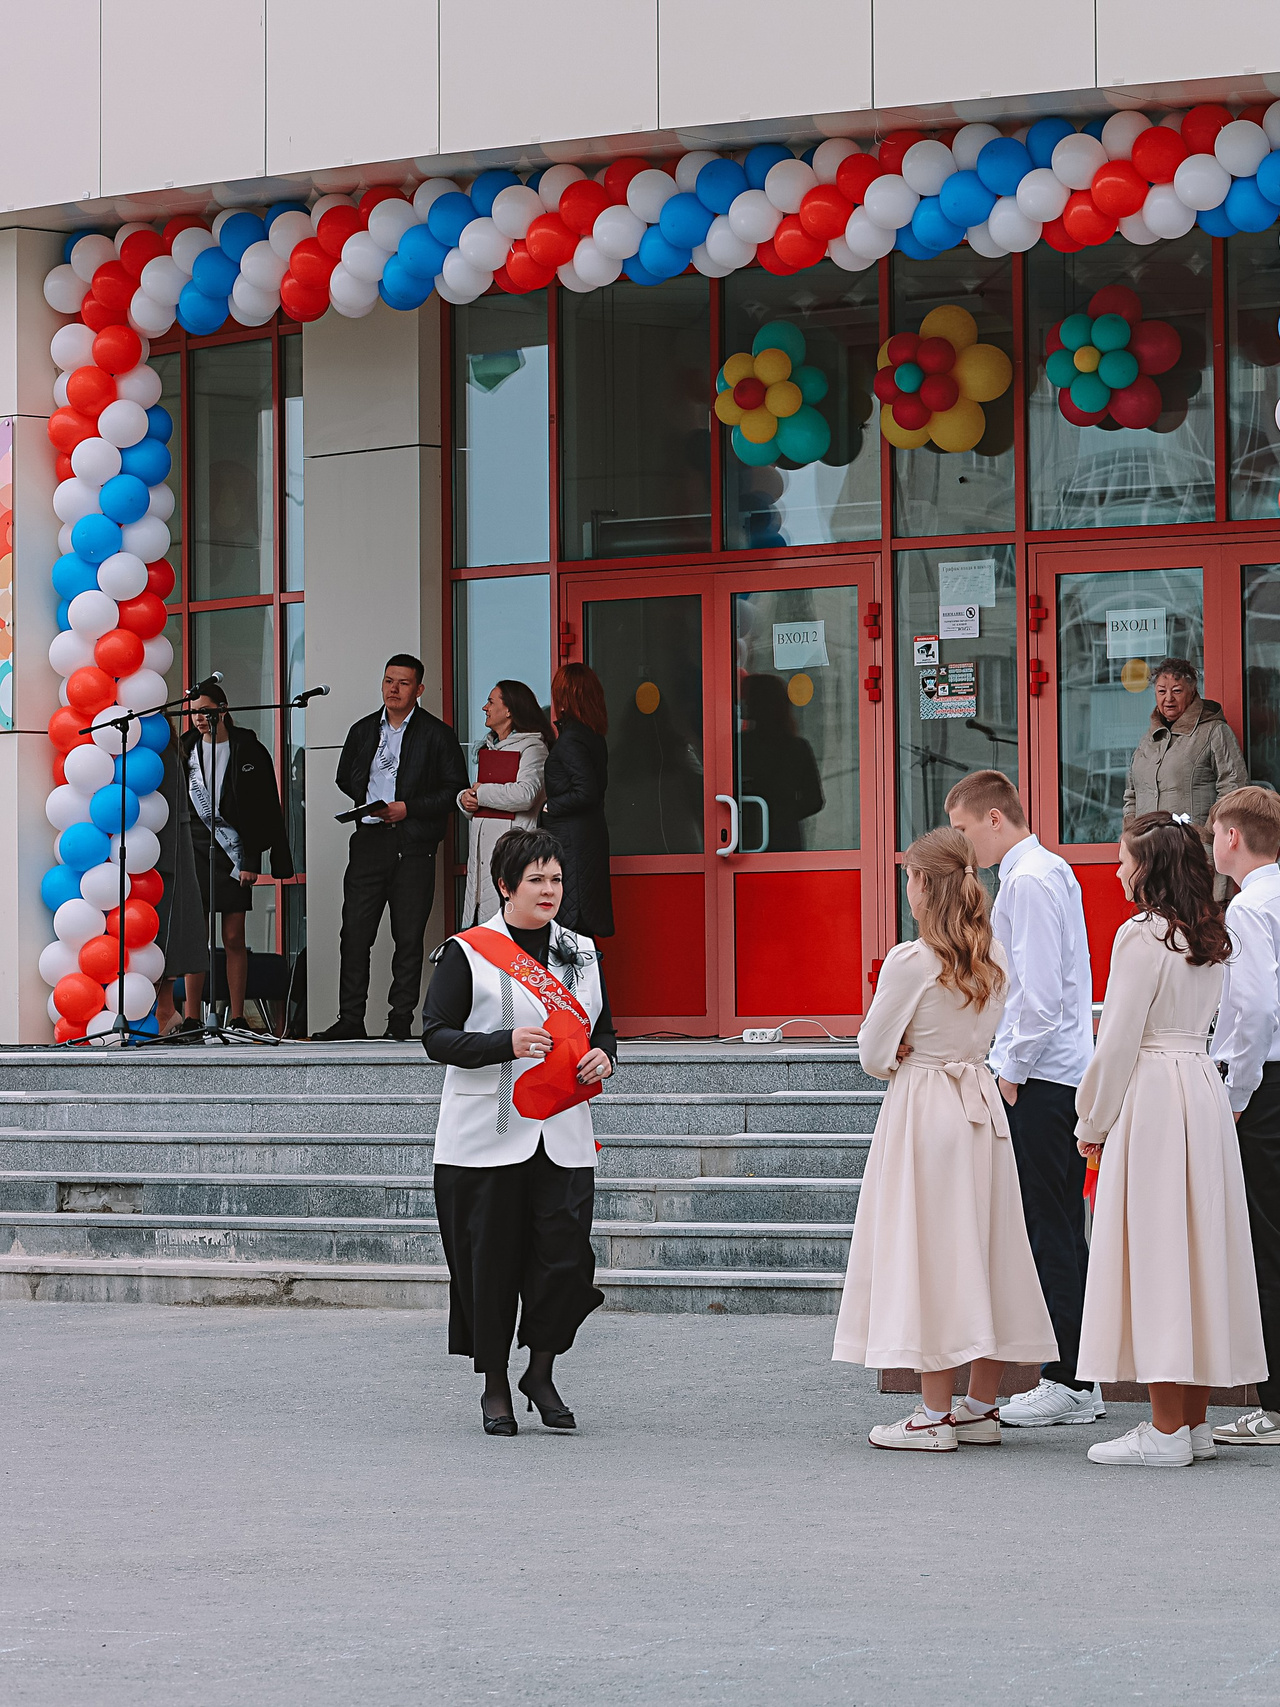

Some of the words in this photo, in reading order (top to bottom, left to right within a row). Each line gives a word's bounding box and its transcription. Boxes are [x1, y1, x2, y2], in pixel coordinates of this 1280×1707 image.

[1111, 618, 1149, 632] ВХОД
[1153, 618, 1157, 630] 1
[777, 631, 810, 645] ВХОД
[811, 630, 818, 642] 2
